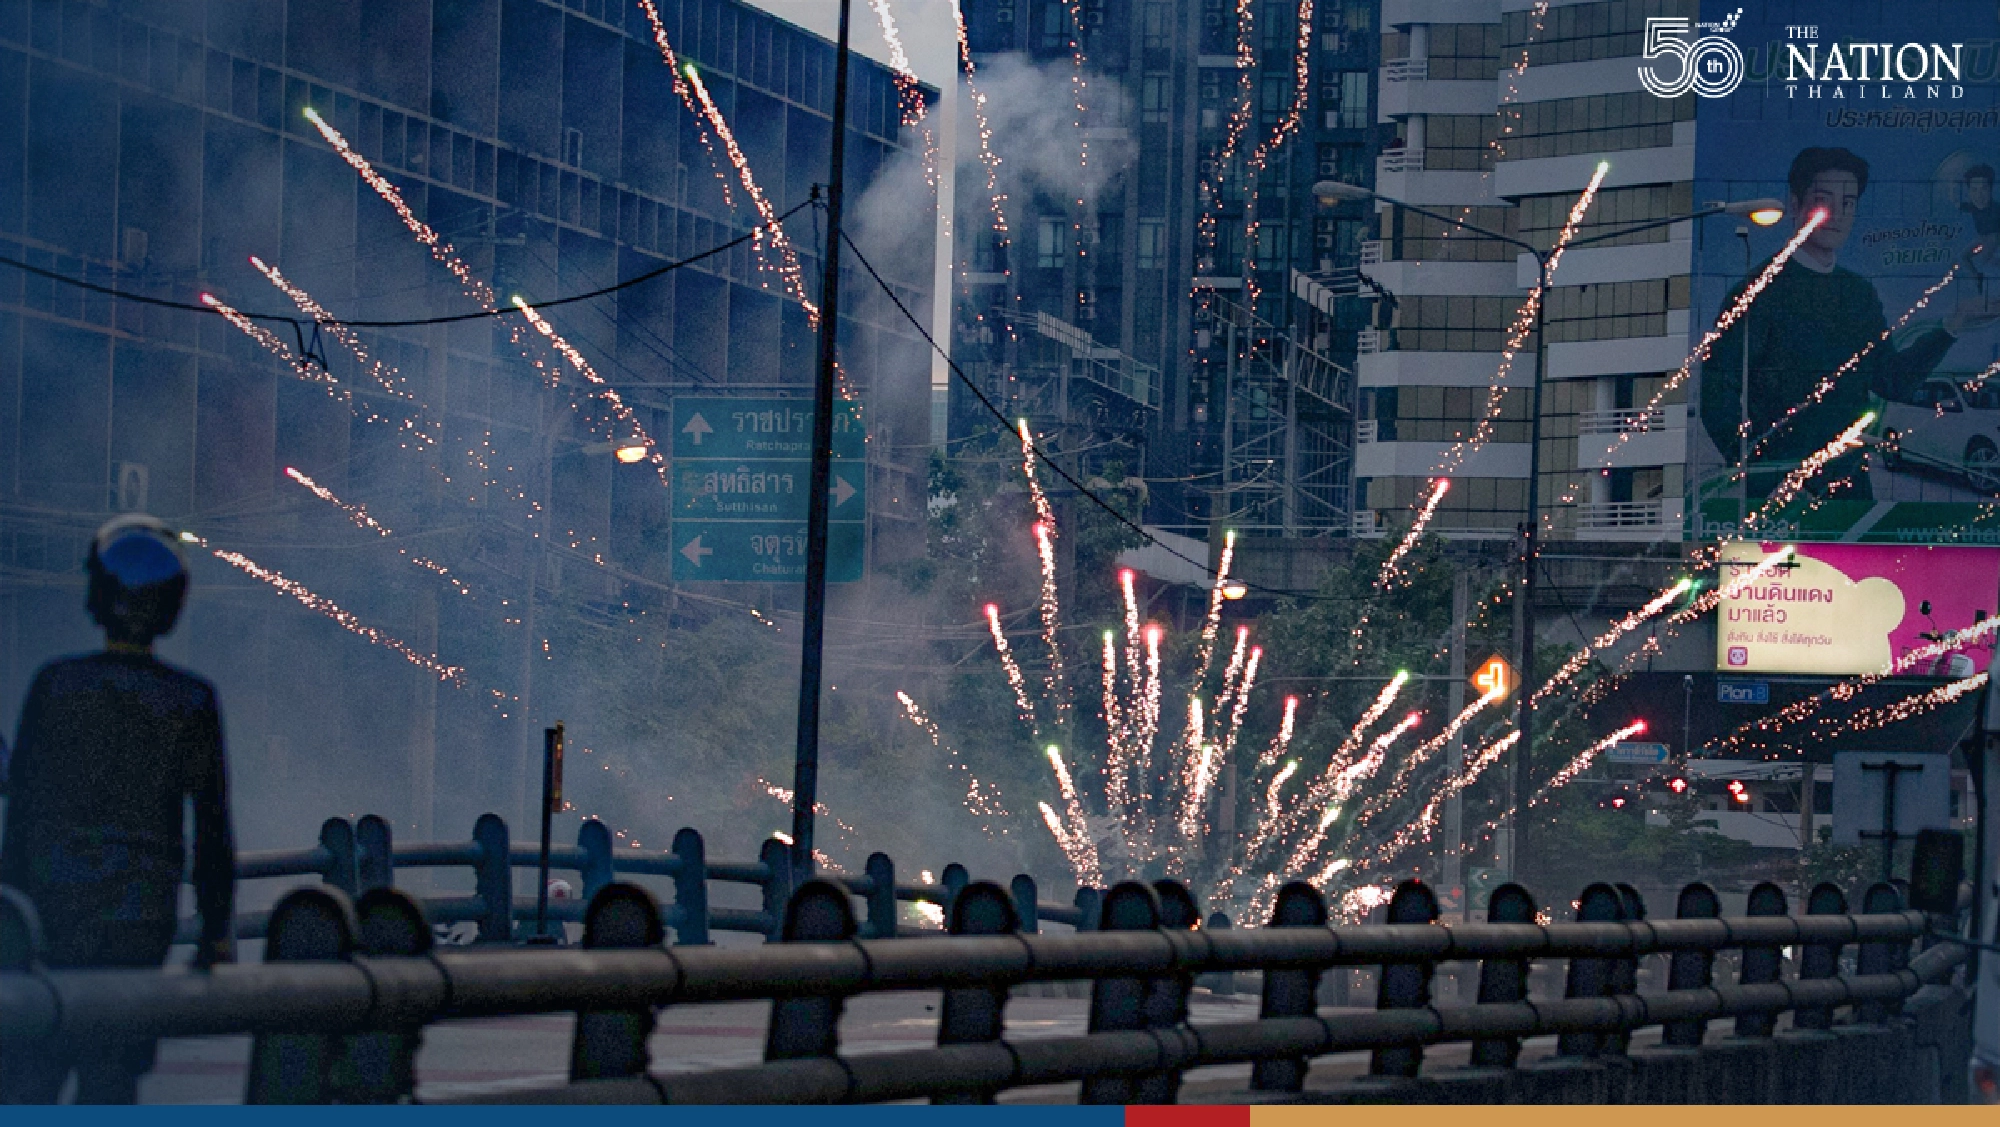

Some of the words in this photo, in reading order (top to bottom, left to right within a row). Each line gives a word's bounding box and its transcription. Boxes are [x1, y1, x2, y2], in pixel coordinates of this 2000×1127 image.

[704, 465, 793, 502] สุทธิสาร
[716, 500, 778, 513] Sutthisan
[1727, 604, 1788, 624] มาแล้ว
